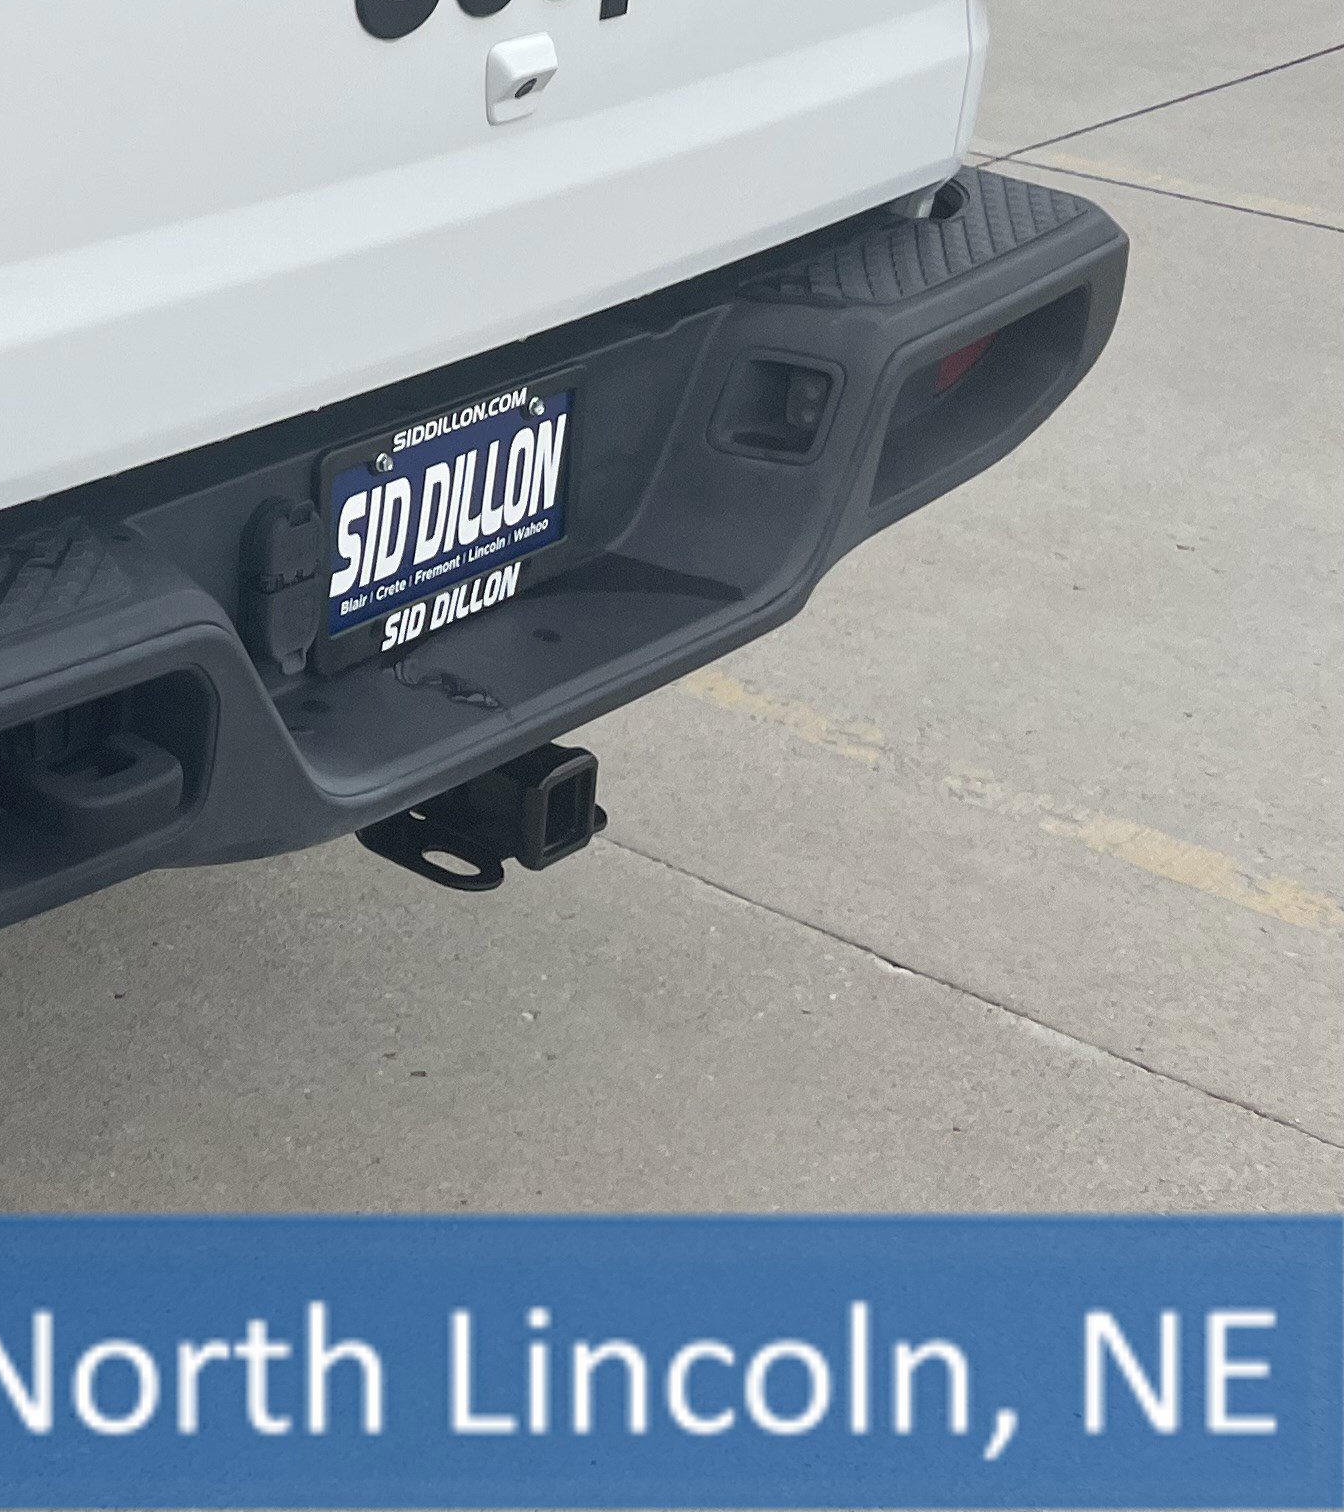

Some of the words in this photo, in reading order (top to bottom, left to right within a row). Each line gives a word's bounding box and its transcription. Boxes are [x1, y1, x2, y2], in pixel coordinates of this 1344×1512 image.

[392, 387, 528, 453] SIDDILLON.COM
[329, 476, 411, 598] SID
[412, 413, 567, 565] DILLON
[340, 592, 368, 617] Blair
[375, 577, 407, 601] Crete
[414, 555, 461, 586] Fremont
[468, 537, 506, 563] Lincoln
[513, 517, 549, 543] Wahoo
[380, 601, 427, 652] SID
[429, 561, 521, 632] DILLON
